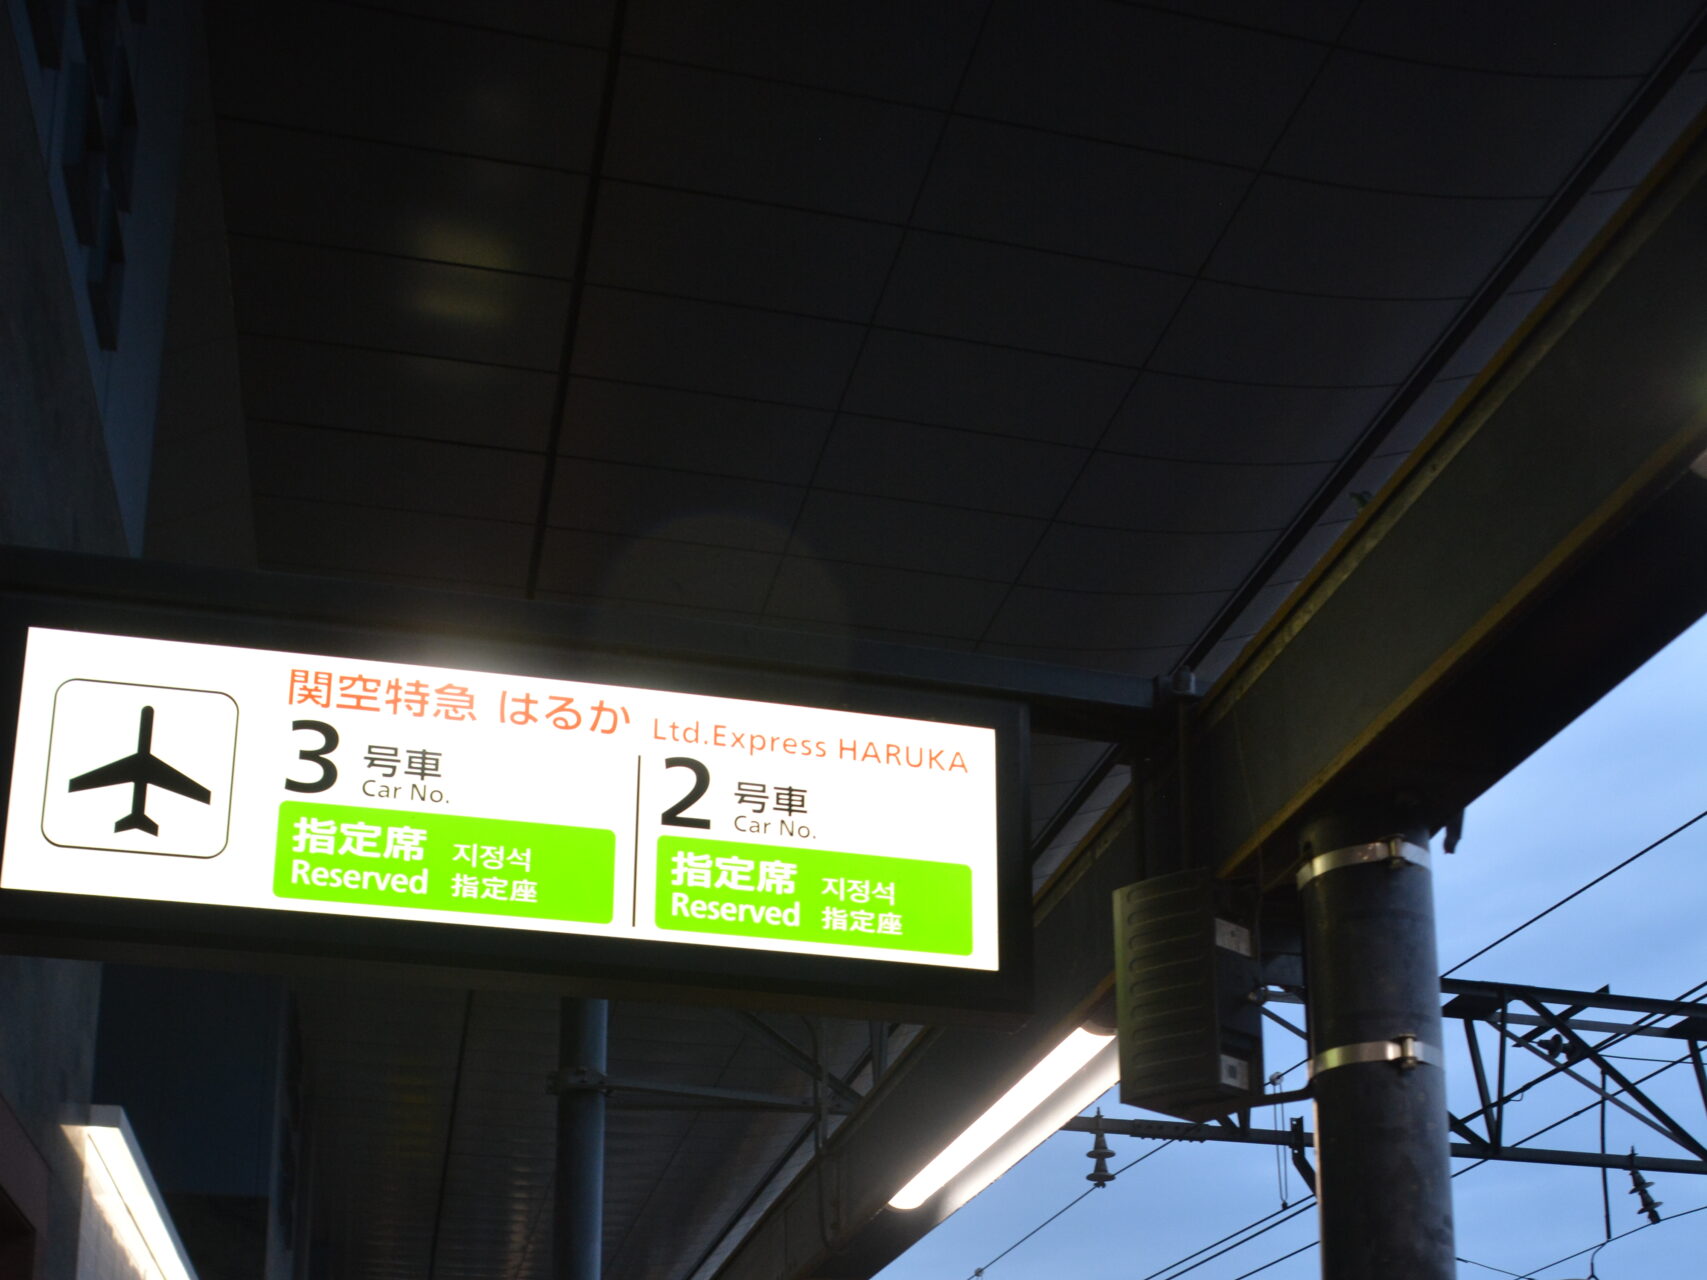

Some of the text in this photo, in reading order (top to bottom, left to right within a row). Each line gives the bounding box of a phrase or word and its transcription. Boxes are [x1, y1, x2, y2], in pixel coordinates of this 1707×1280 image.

[287, 668, 631, 735] 関空特急 はるか
[284, 719, 443, 794] 3 号車
[839, 738, 969, 774] HARUKA
[362, 779, 450, 804] Car No.
[660, 756, 808, 831] 2 号車
[292, 817, 428, 862] 指定席
[733, 815, 817, 840] Car No.
[452, 842, 533, 872] 지정석
[671, 850, 798, 896] 指定席
[291, 859, 429, 895] Reserved
[450, 873, 538, 904] 指定座
[821, 876, 896, 906] 지정석
[671, 892, 801, 928] Reserved
[821, 906, 903, 937] 指定座
